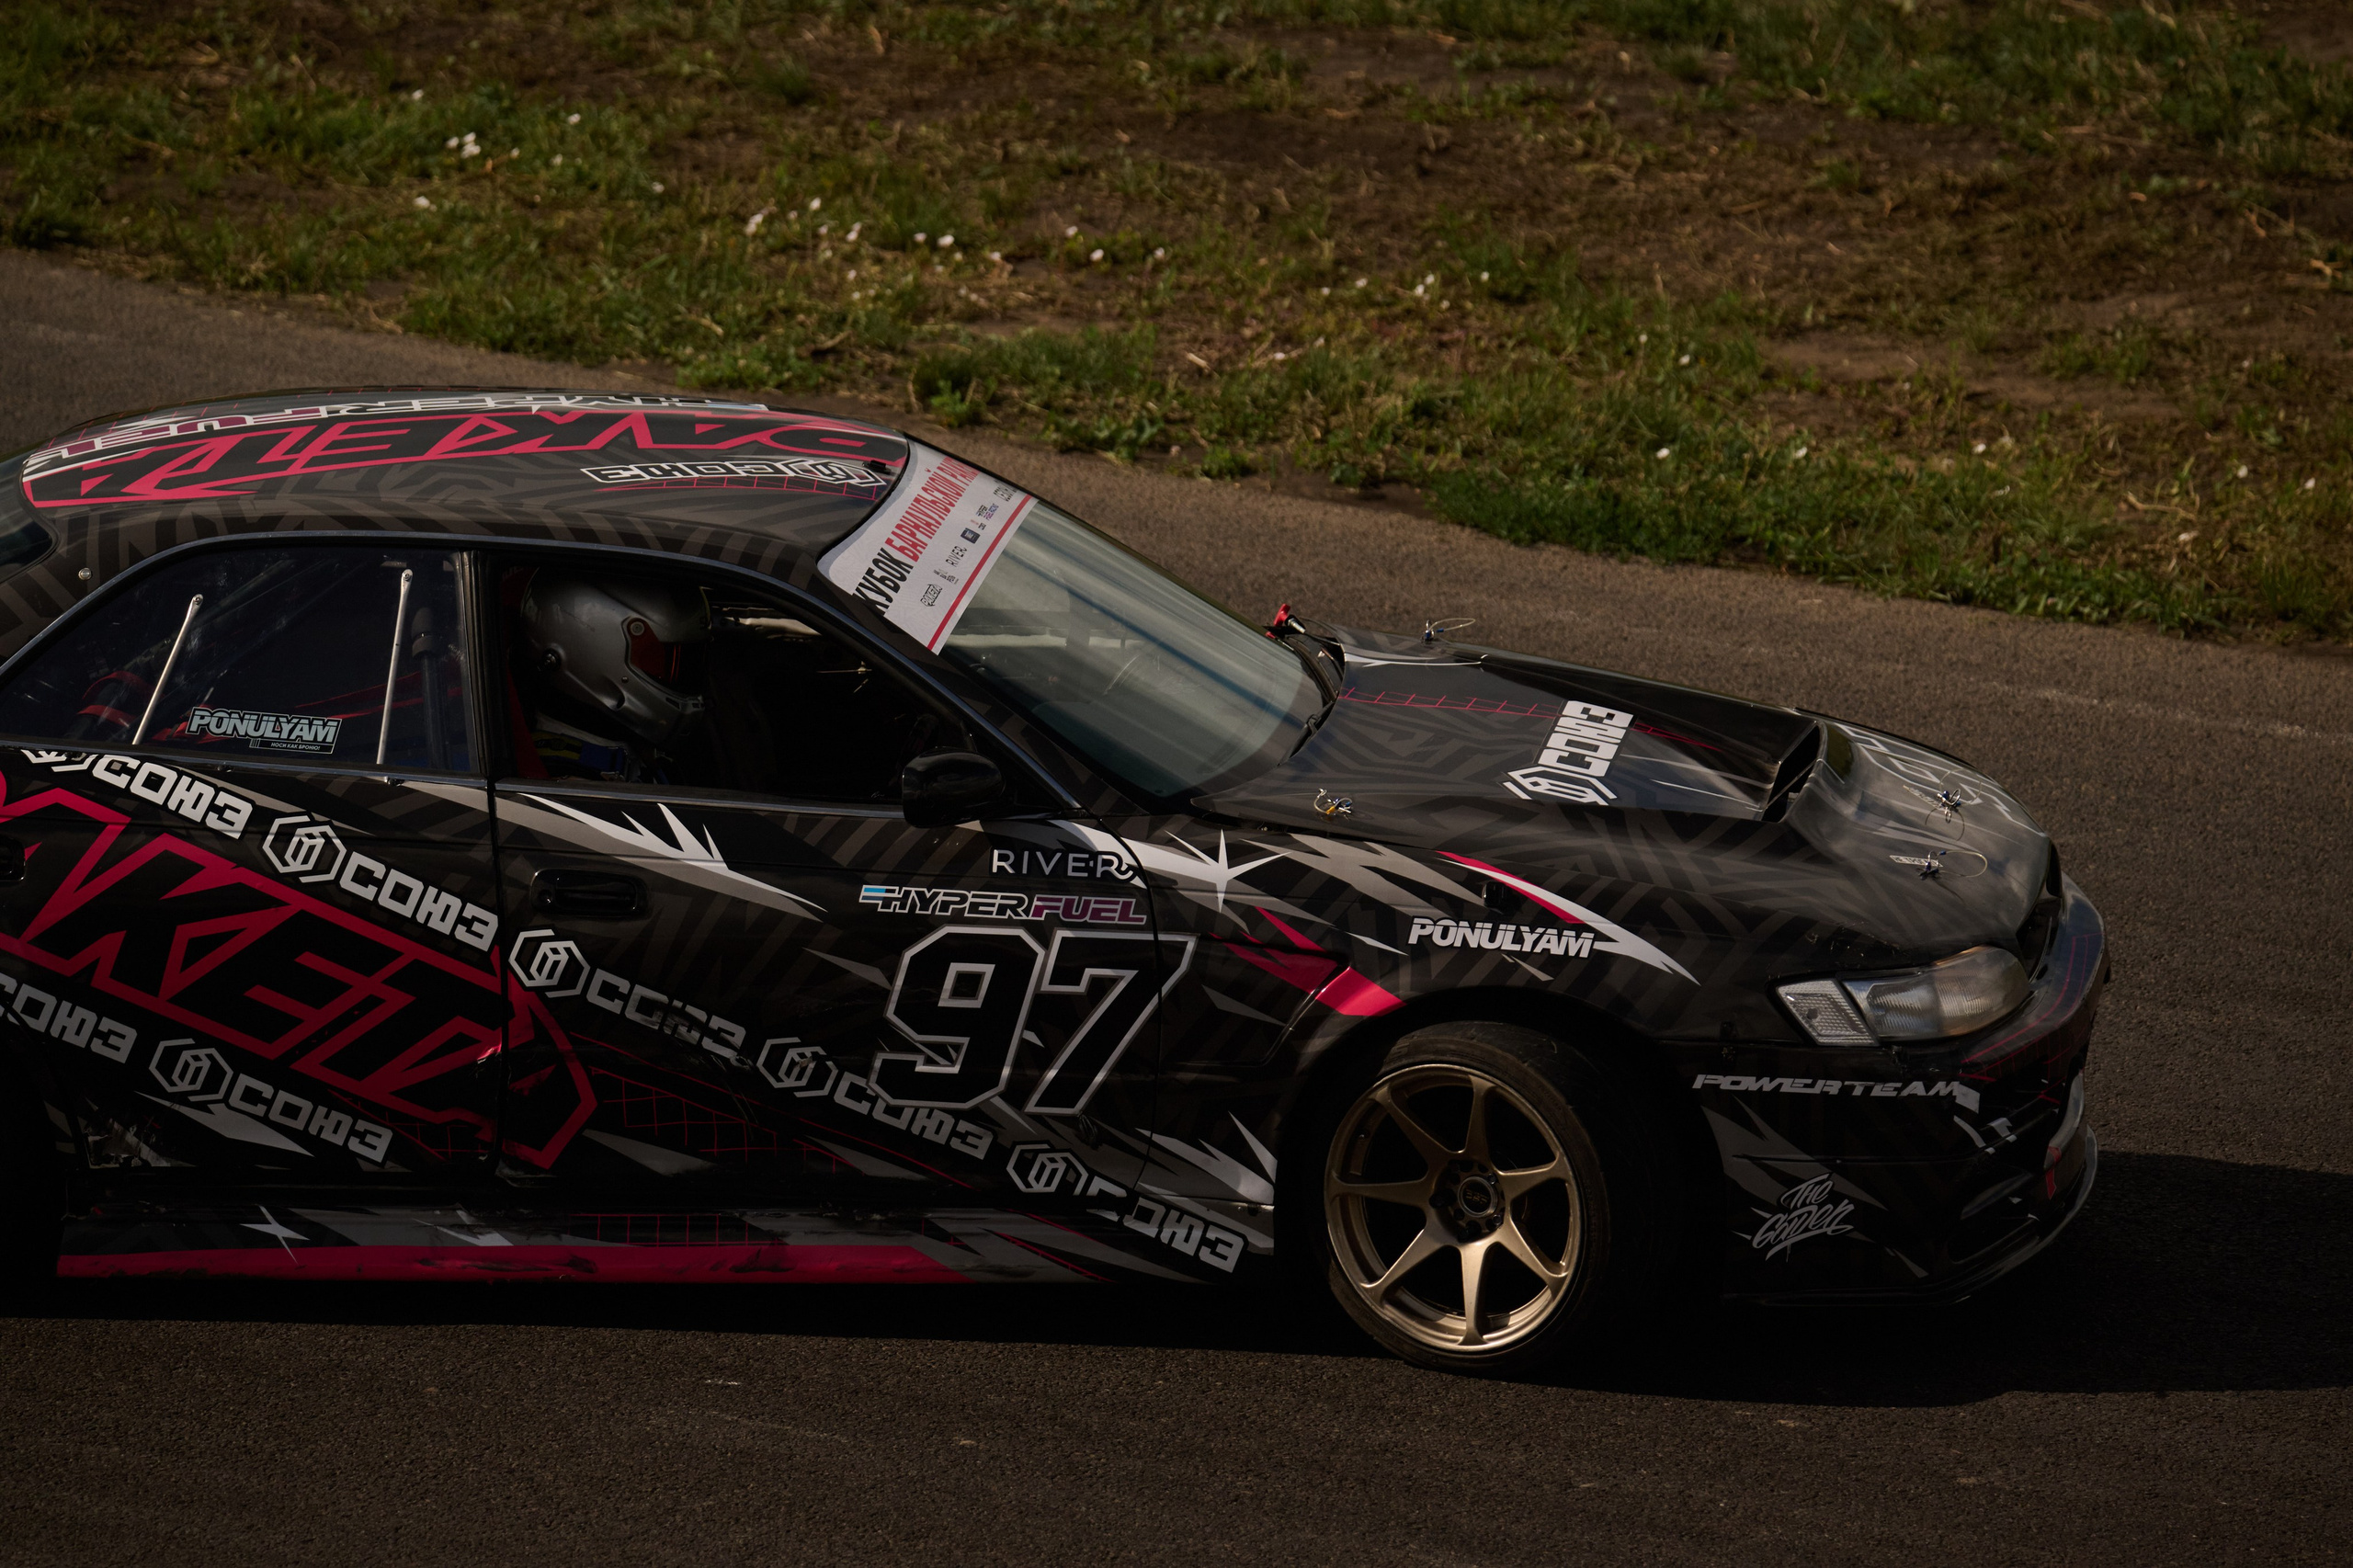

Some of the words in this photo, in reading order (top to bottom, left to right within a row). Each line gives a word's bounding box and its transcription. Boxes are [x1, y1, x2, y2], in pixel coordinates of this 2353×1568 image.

[853, 548, 914, 615] КУБОК
[885, 468, 966, 562] БАРНАУЛЬСКОЙ
[188, 710, 339, 744] PONULYAM
[992, 849, 1134, 881] RIVER
[859, 884, 1147, 926] HYPERFUEL
[1407, 917, 1596, 959] PONULYAM
[866, 924, 1200, 1116] 97
